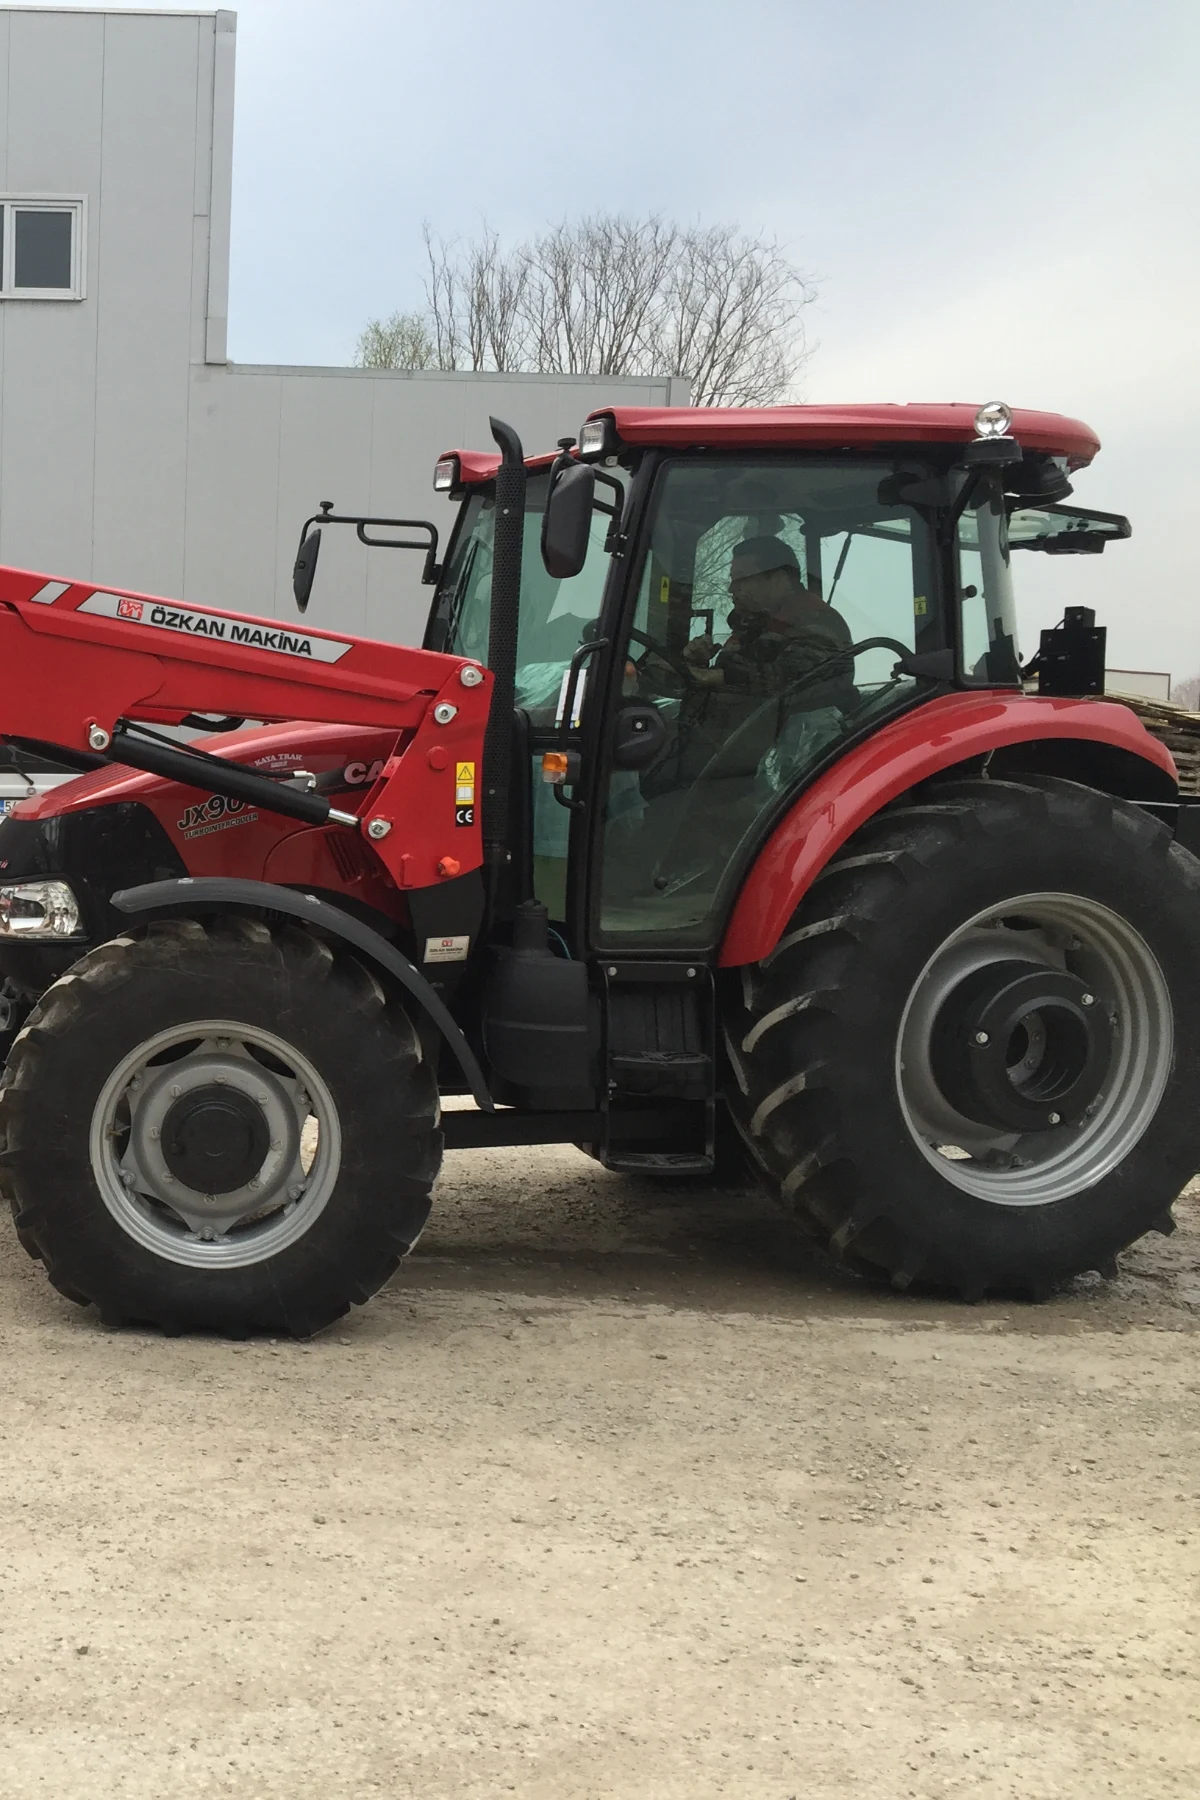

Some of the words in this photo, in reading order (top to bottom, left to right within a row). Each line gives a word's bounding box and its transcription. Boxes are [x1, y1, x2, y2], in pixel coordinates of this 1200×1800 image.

[150, 606, 226, 637] ÖZKAN
[230, 624, 312, 656] MAKİNA
[254, 754, 277, 767] KAYA
[184, 812, 258, 840] TURBOINTERCOOLER
